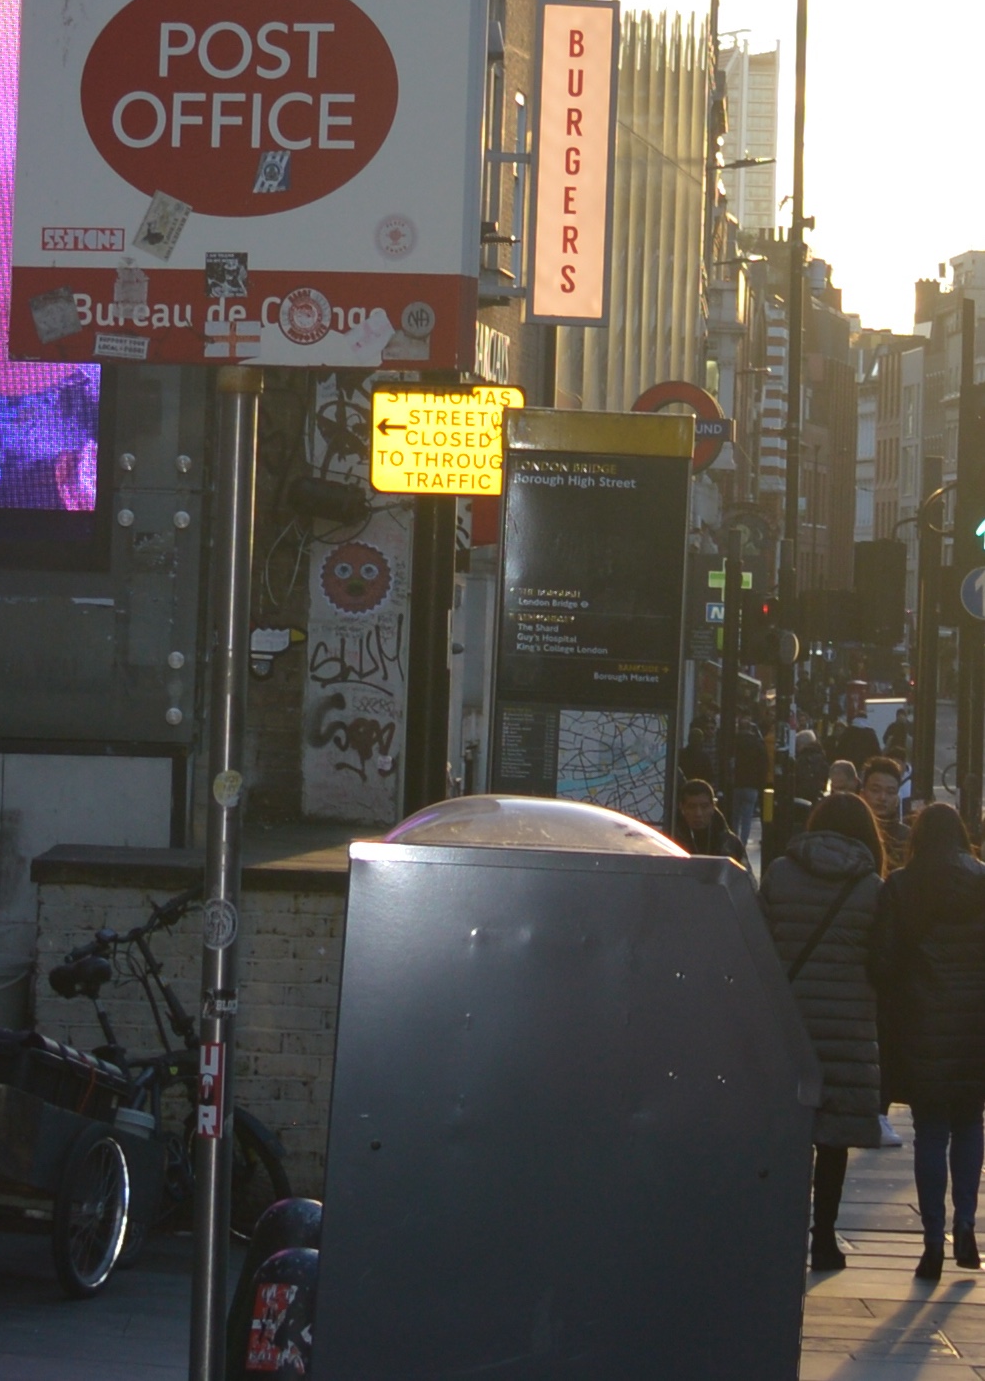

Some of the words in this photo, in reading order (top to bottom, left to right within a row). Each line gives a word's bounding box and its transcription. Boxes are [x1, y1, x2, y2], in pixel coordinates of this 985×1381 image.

[158, 20, 335, 79] POST
[112, 90, 356, 151] OFFICE
[560, 29, 585, 294] BURGERS
[75, 293, 192, 329] Bureau
[207, 293, 247, 328] de
[388, 387, 410, 403] ST
[420, 387, 511, 406] THOMAS
[408, 409, 488, 427] STREET
[405, 431, 490, 449] CLOSED
[377, 450, 404, 467] TO
[412, 452, 503, 470] THROUG
[514, 460, 570, 473] LONDON
[572, 463, 617, 475] BRIDGE
[404, 472, 491, 490] TRAFFIC
[514, 472, 564, 487] Borough
[568, 473, 596, 489] High
[599, 476, 638, 489] Street
[518, 597, 550, 607] London
[552, 598, 578, 610] Bridge
[517, 623, 533, 632] The
[535, 623, 559, 633] Shard
[542, 634, 577, 645] Hospital
[543, 644, 575, 655] College
[577, 646, 608, 655] London
[593, 671, 628, 683] Borough
[630, 673, 659, 683] Market
